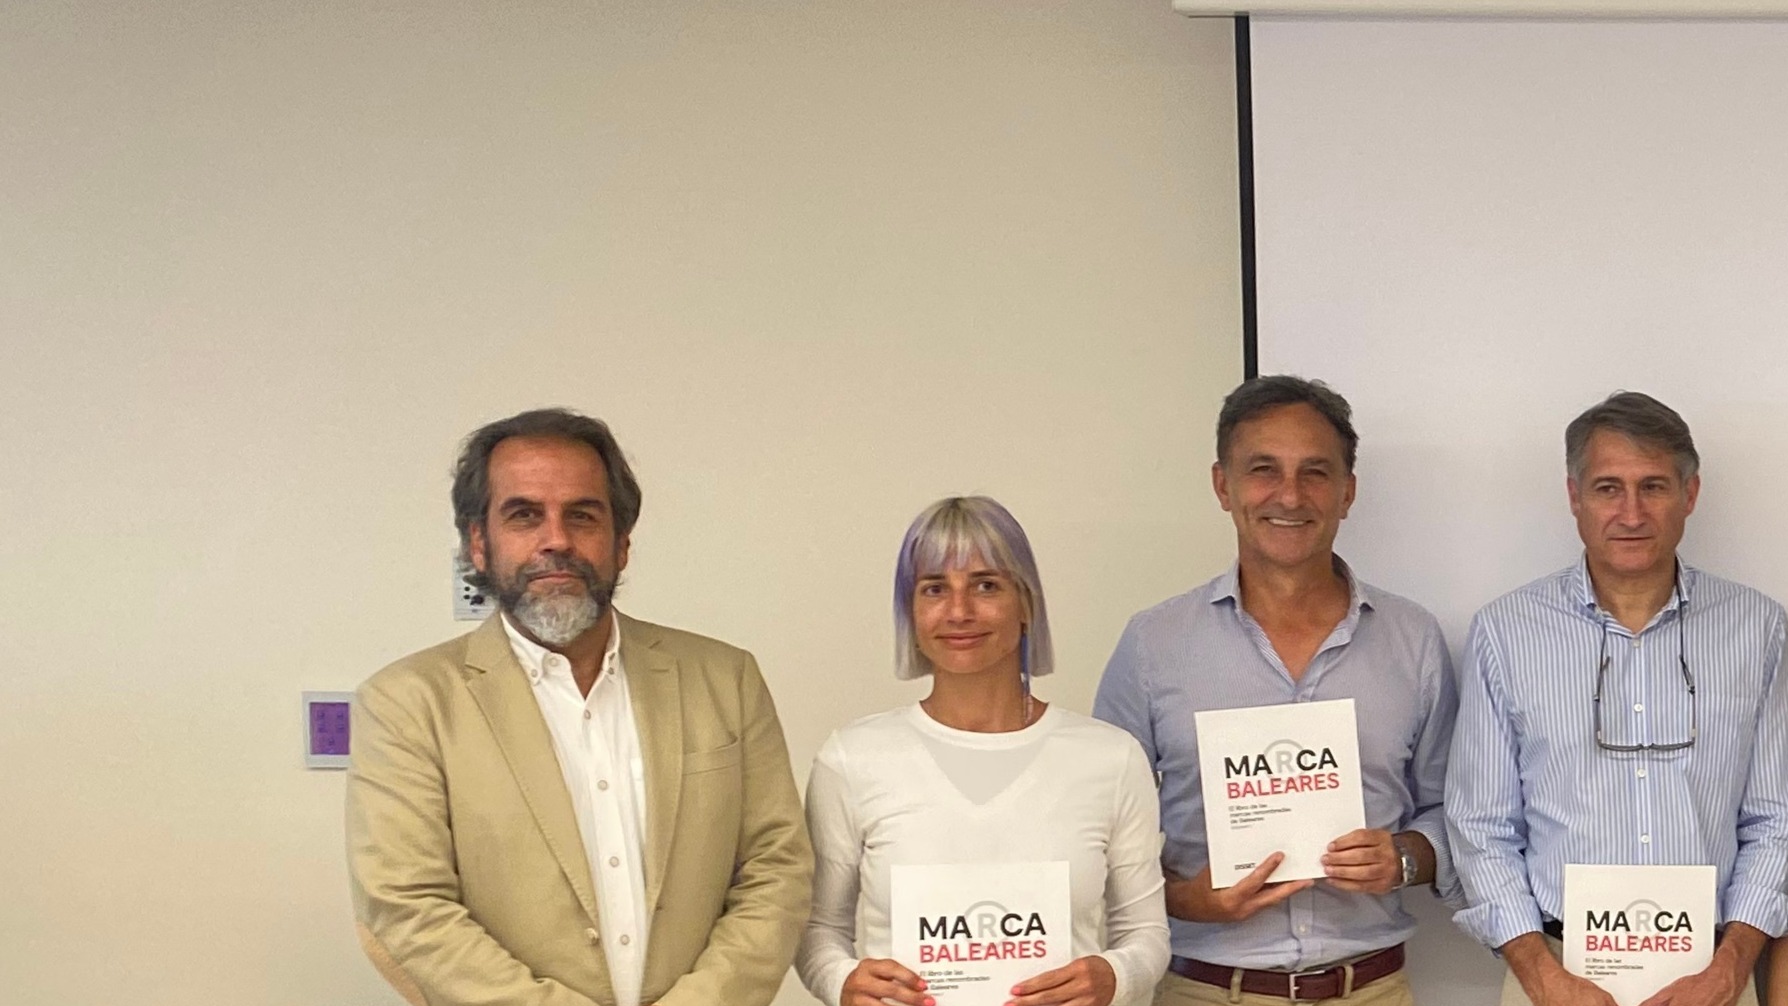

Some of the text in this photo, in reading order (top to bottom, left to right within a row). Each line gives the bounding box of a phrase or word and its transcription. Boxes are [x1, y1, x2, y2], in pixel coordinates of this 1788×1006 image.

[1224, 748, 1338, 779] MARCA
[1227, 773, 1340, 800] BALEARES
[919, 912, 1047, 941] MARCA
[1586, 910, 1693, 932] MARCA
[919, 940, 1047, 963] BALEARES
[1586, 935, 1692, 952] BALEARES
